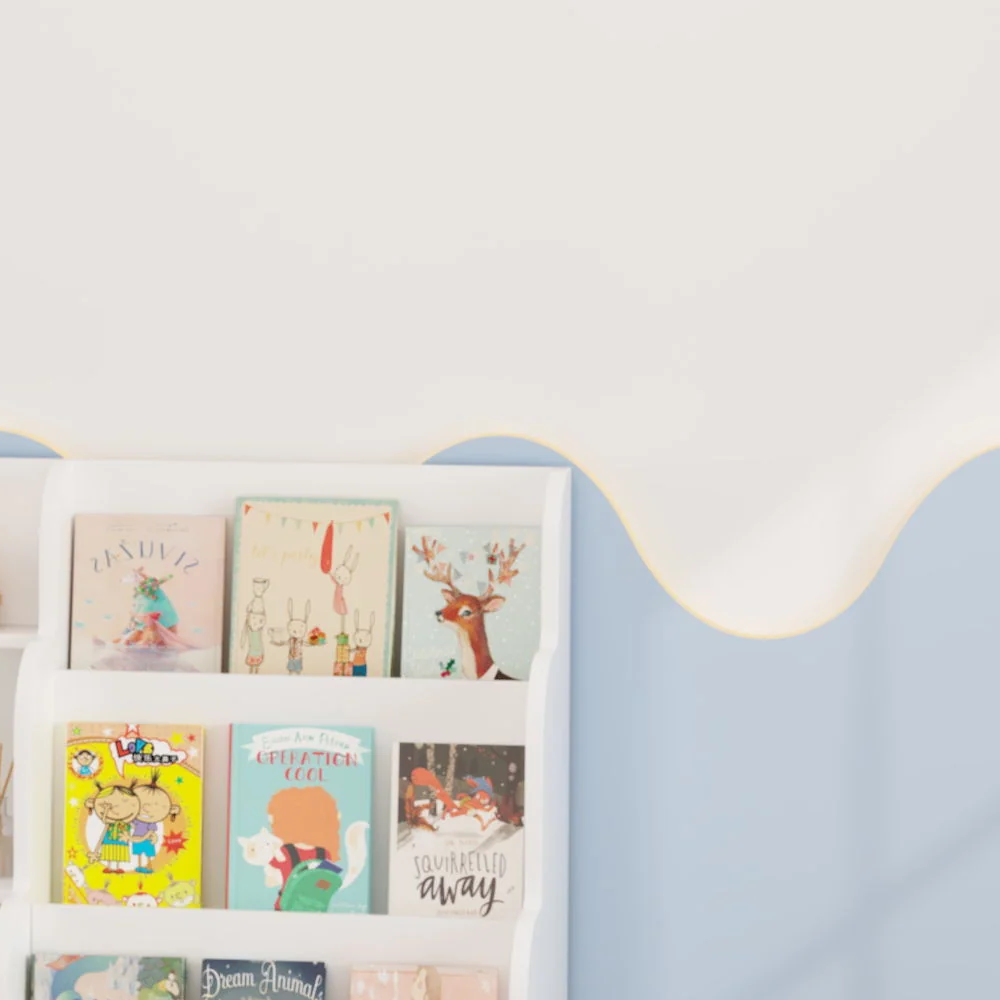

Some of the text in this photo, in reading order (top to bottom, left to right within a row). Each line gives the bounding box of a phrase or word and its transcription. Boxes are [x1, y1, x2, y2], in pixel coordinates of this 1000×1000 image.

[256, 750, 358, 767] OPERATION
[284, 767, 329, 782] COOL
[414, 851, 507, 879] SQUIRRELLED
[416, 875, 504, 917] away
